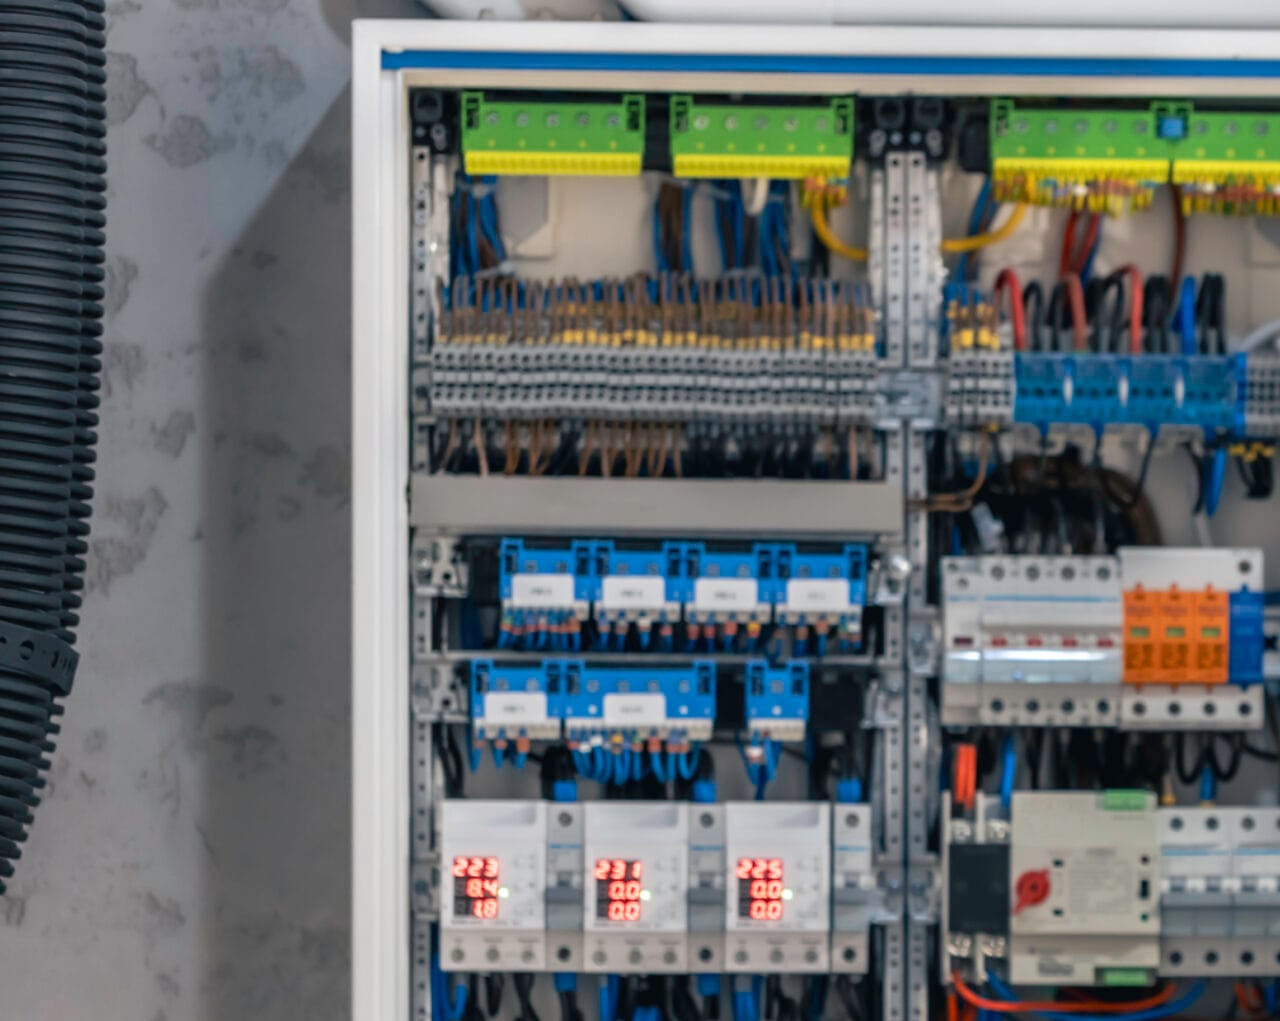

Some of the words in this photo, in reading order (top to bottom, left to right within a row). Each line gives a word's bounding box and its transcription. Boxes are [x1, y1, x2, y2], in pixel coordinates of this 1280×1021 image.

[452, 856, 499, 877] 223
[593, 859, 642, 880] 231
[736, 857, 784, 879] 225
